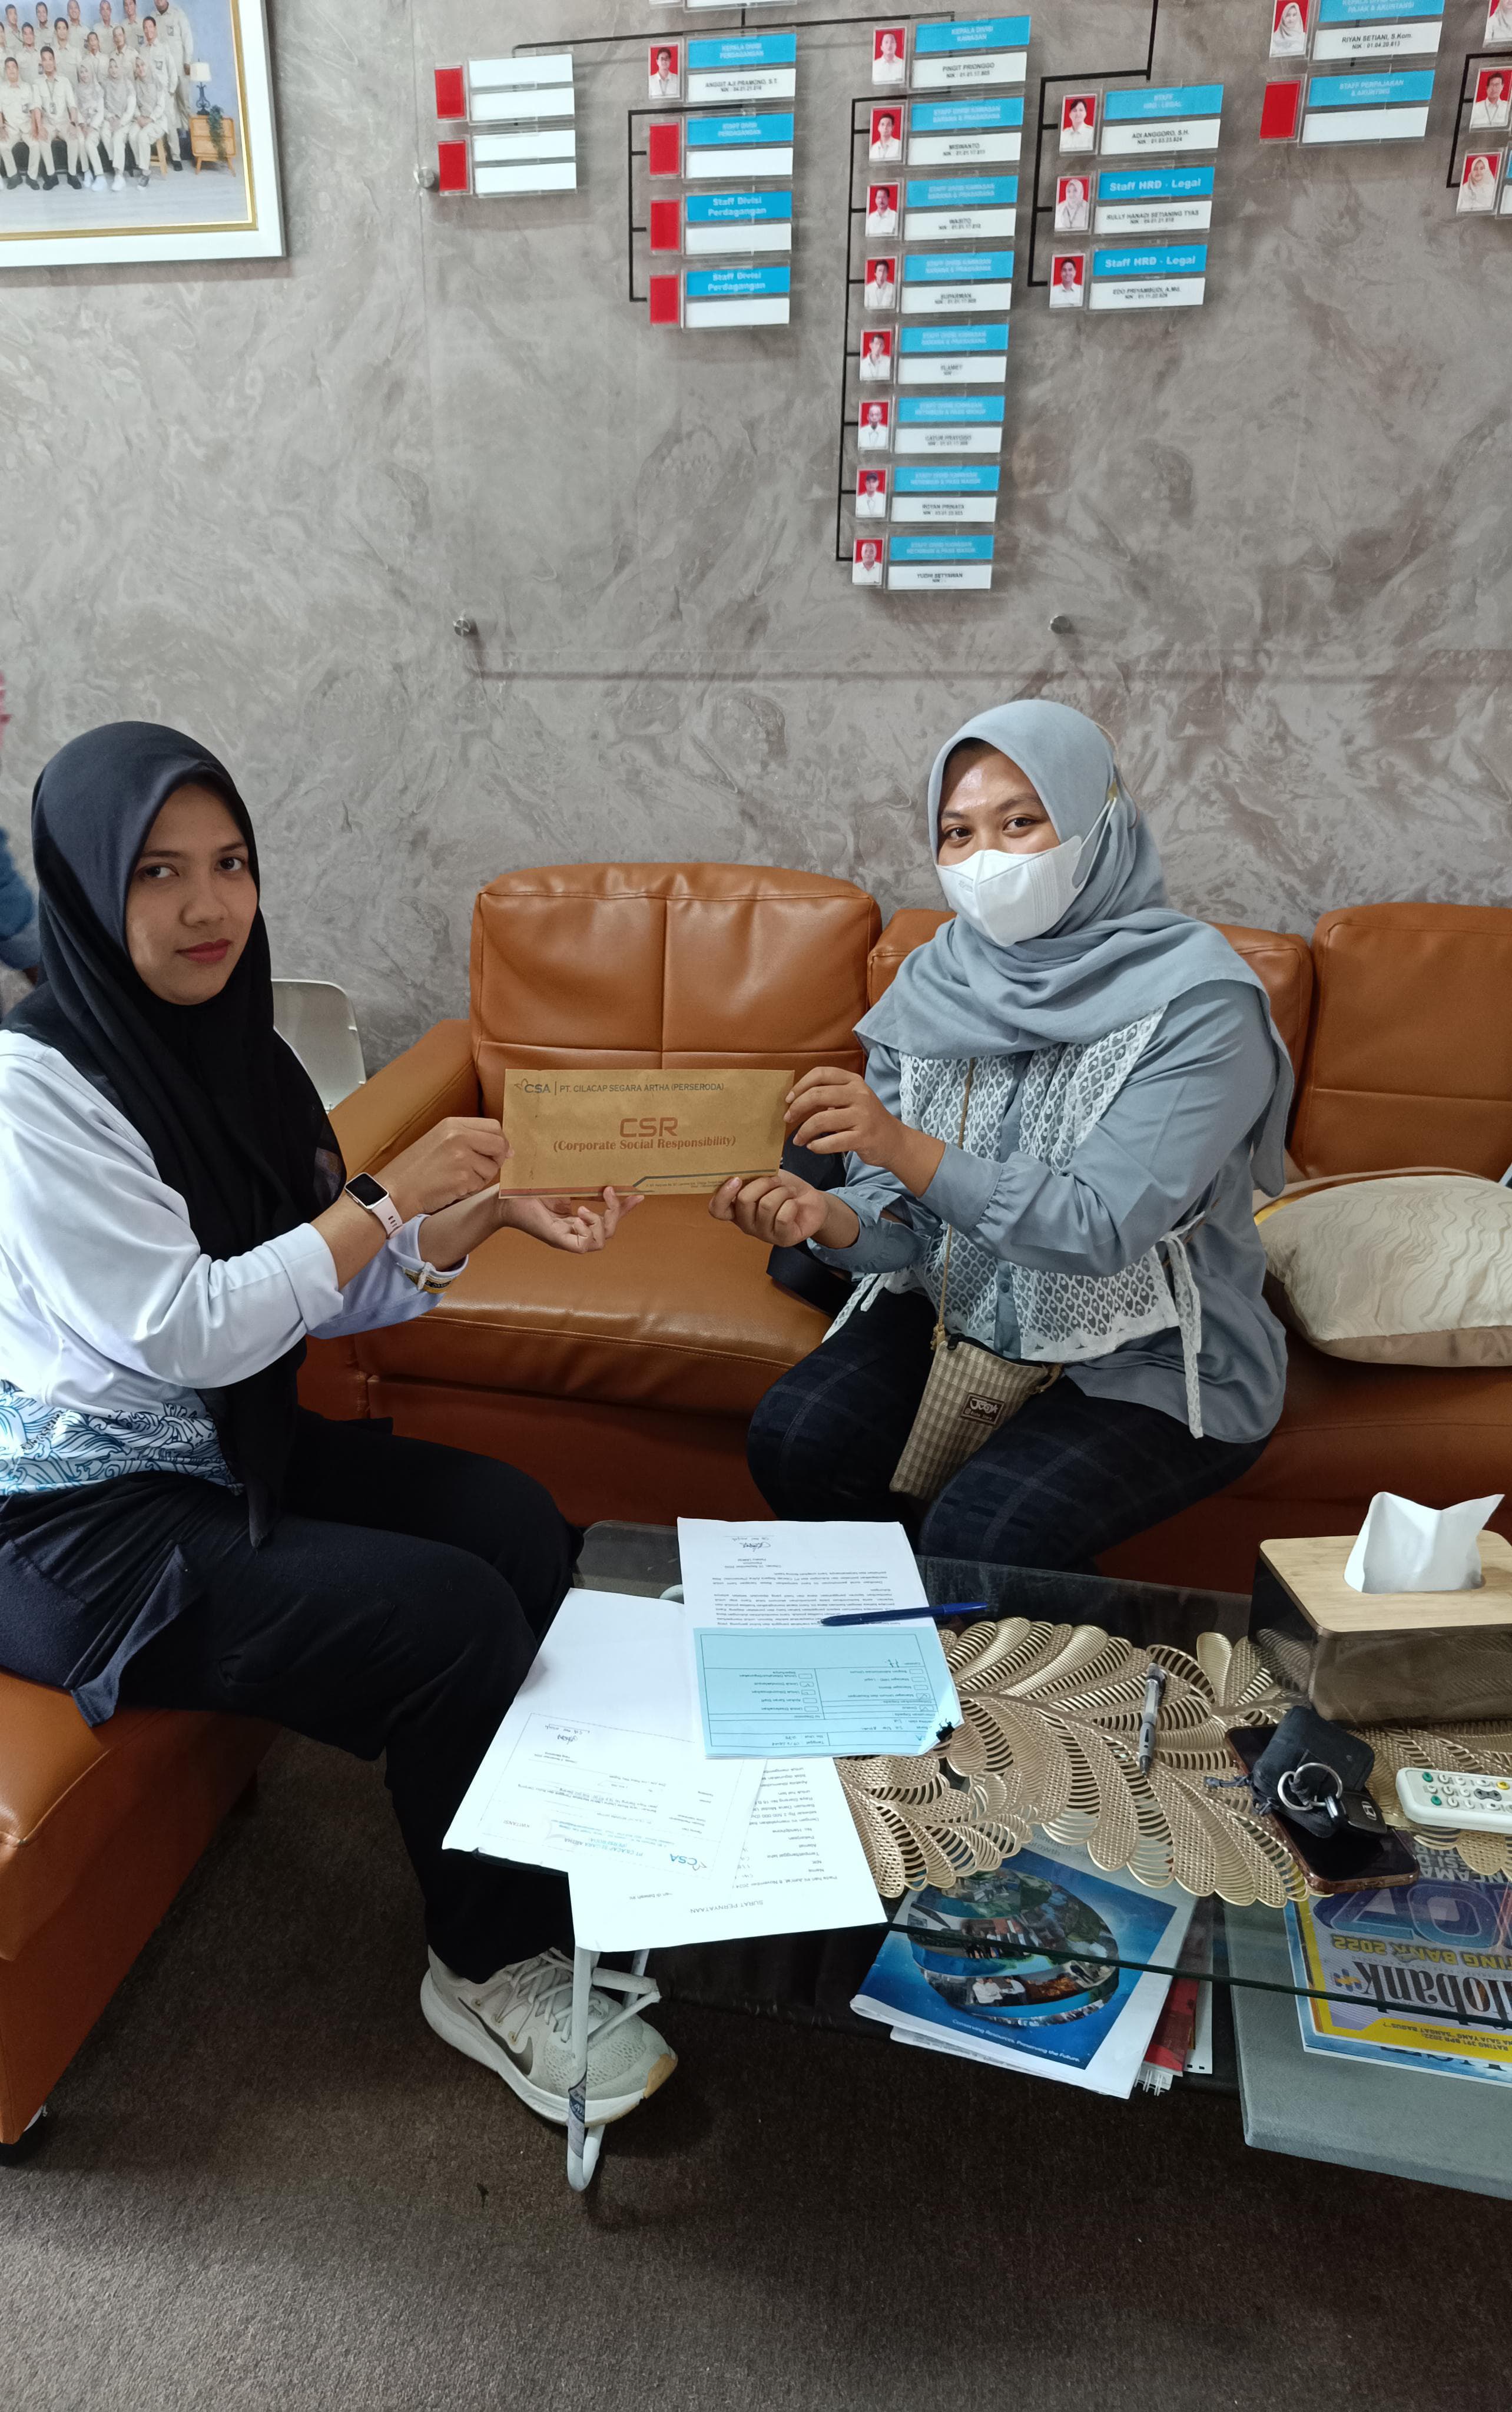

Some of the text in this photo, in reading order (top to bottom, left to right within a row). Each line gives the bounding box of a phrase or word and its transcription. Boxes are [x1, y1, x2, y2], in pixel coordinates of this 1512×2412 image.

[1109, 177, 1202, 191] Staff HRD Legal
[712, 196, 762, 206] Staff Divisi
[708, 207, 767, 217] Perdagangan
[1105, 255, 1196, 268] Staff HRD Legal
[712, 273, 734, 281] Staff
[708, 282, 766, 291] Perdagangan
[524, 1082, 724, 1094] CSA PT. CILACAP SEGARA ARTHA (PERSERODA)
[619, 1116, 679, 1138] CSR
[552, 1135, 737, 1152] (Corporate Social Responsibility)
[669, 1853, 698, 1866] CSA
[689, 1899, 764, 1914] SURAT PERNYATAAN
[1331, 1933, 1388, 1955] 2022
[1389, 1942, 1459, 1966] BANK
[952, 2019, 985, 2034] Conserving
[1016, 2040, 1048, 2054] Preserving
[1478, 2042, 1509, 2052] RATING
